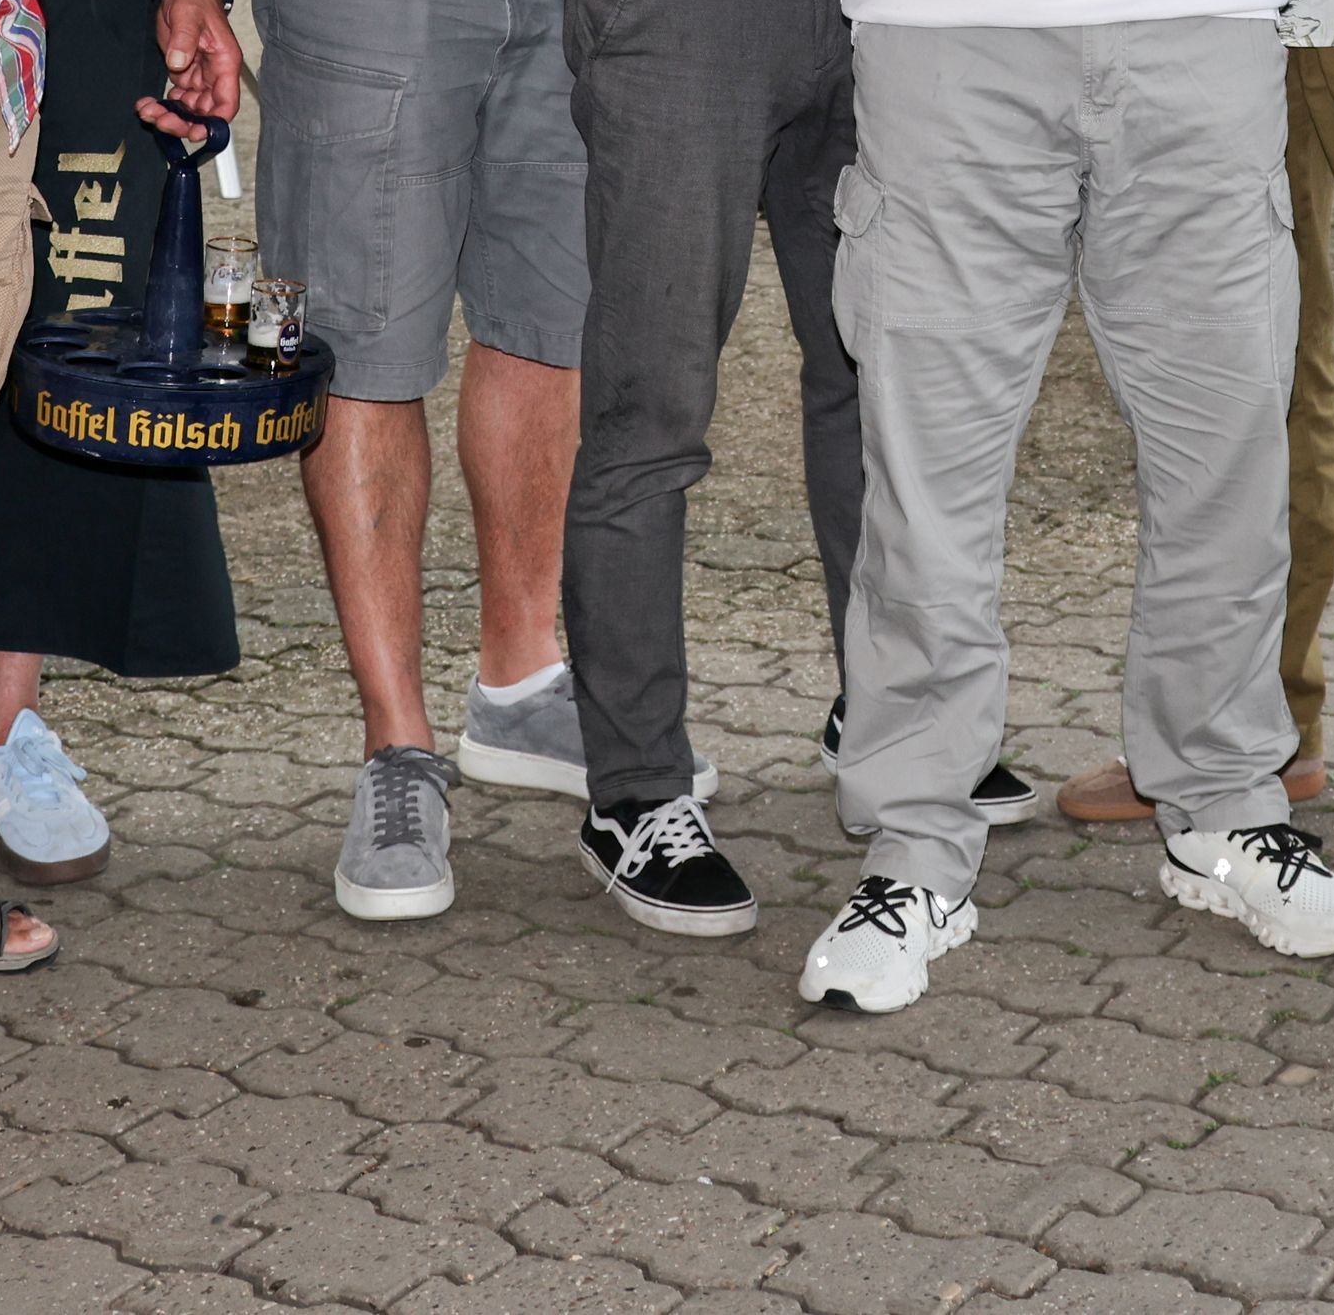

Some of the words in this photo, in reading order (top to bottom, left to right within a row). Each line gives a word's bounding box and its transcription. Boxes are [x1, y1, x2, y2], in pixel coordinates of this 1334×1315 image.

[36, 389, 117, 444] Gaffel
[128, 408, 241, 451] Kölsch
[255, 400, 318, 446] Gaffel
